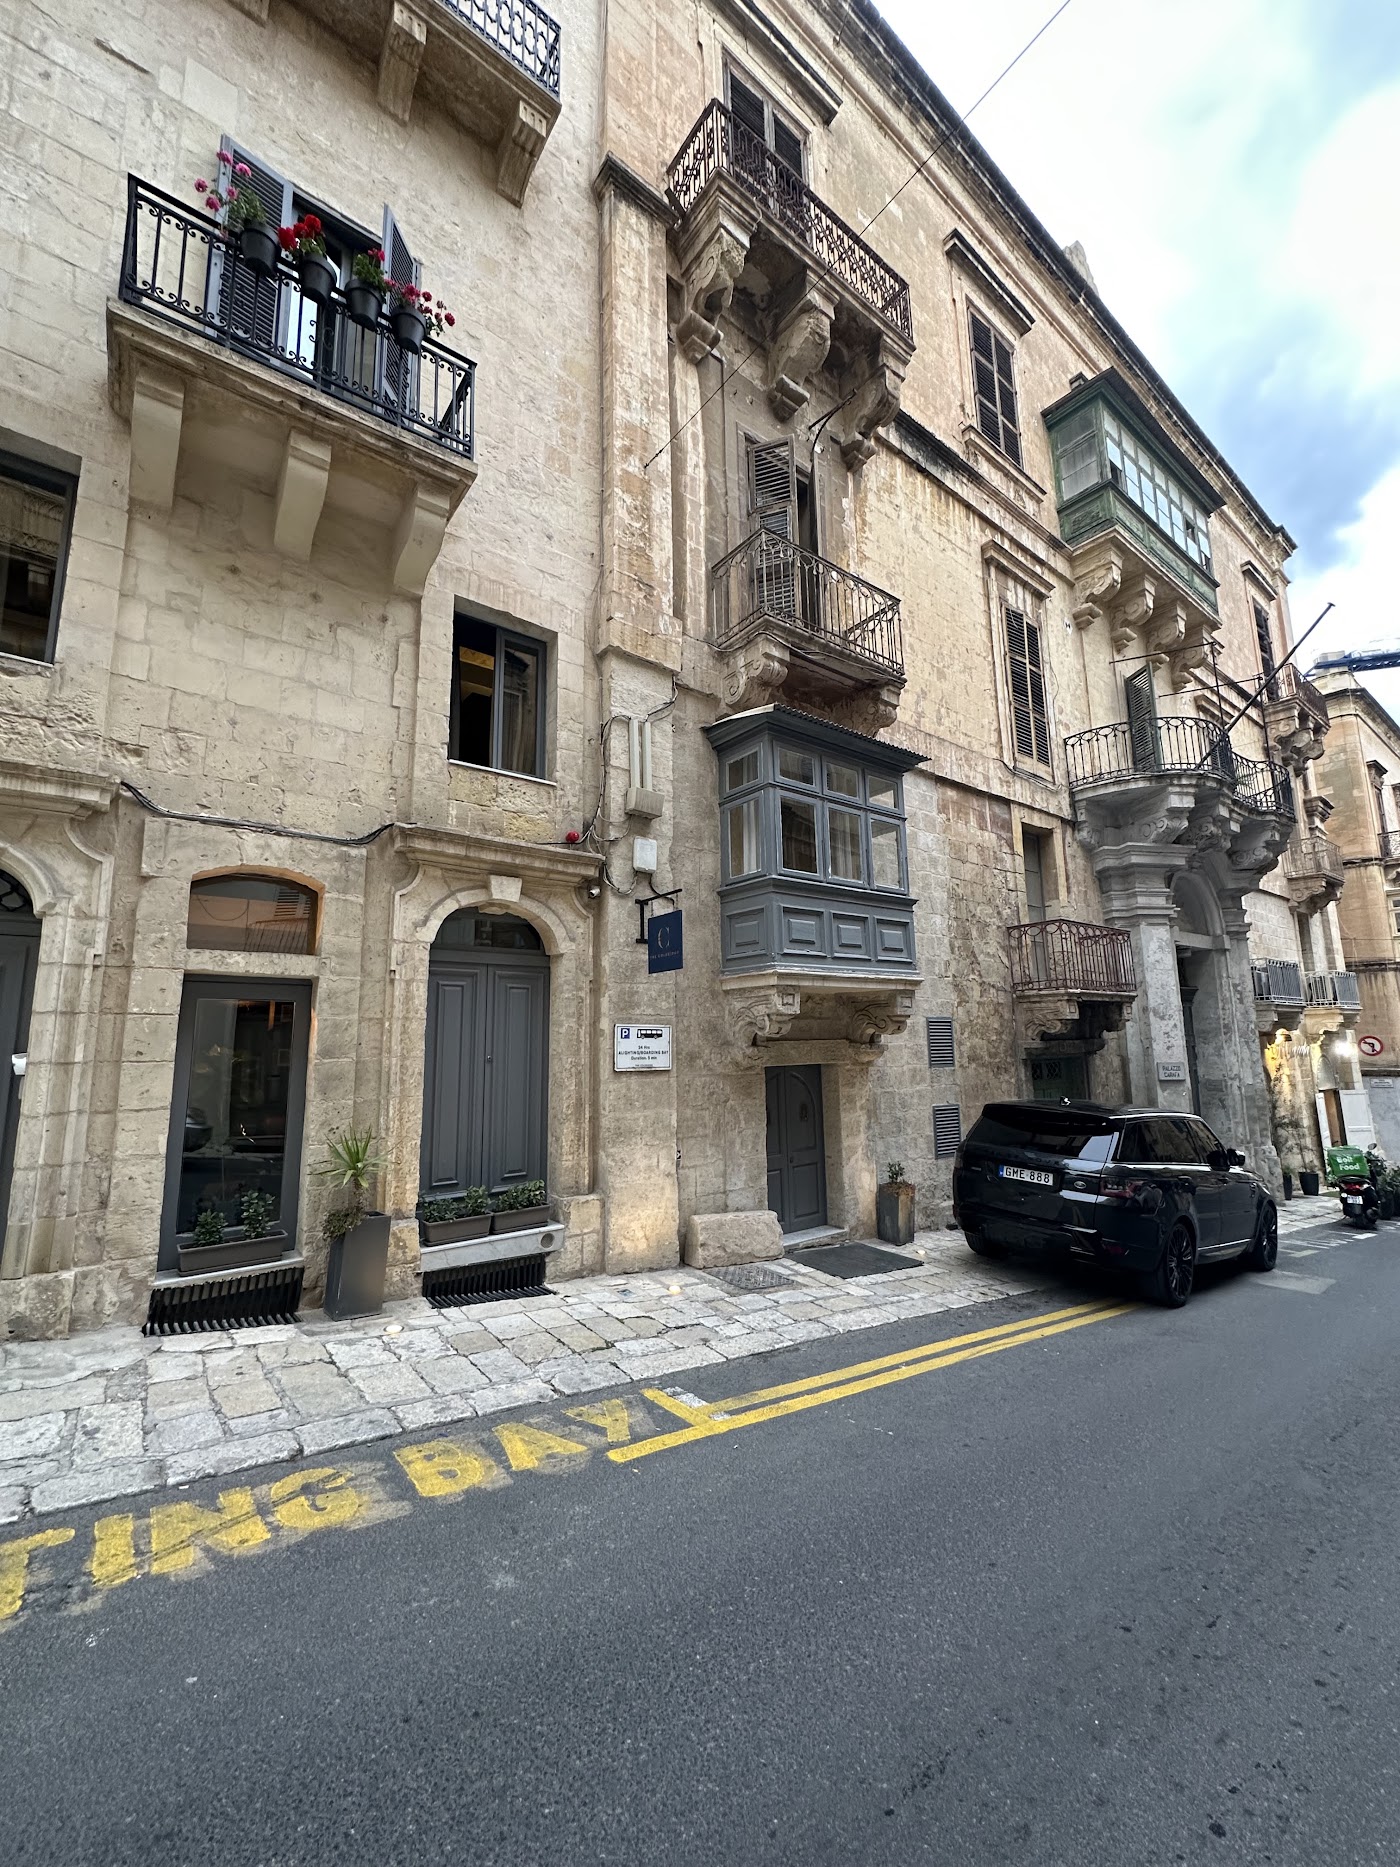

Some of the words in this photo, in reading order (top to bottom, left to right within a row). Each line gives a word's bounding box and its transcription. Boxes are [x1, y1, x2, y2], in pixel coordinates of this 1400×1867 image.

[622, 1028, 629, 1038] P
[1339, 1162, 1360, 1171] Food
[1005, 1167, 1026, 1180] GME
[1029, 1170, 1050, 1184] 888
[393, 1398, 632, 1498] BAY
